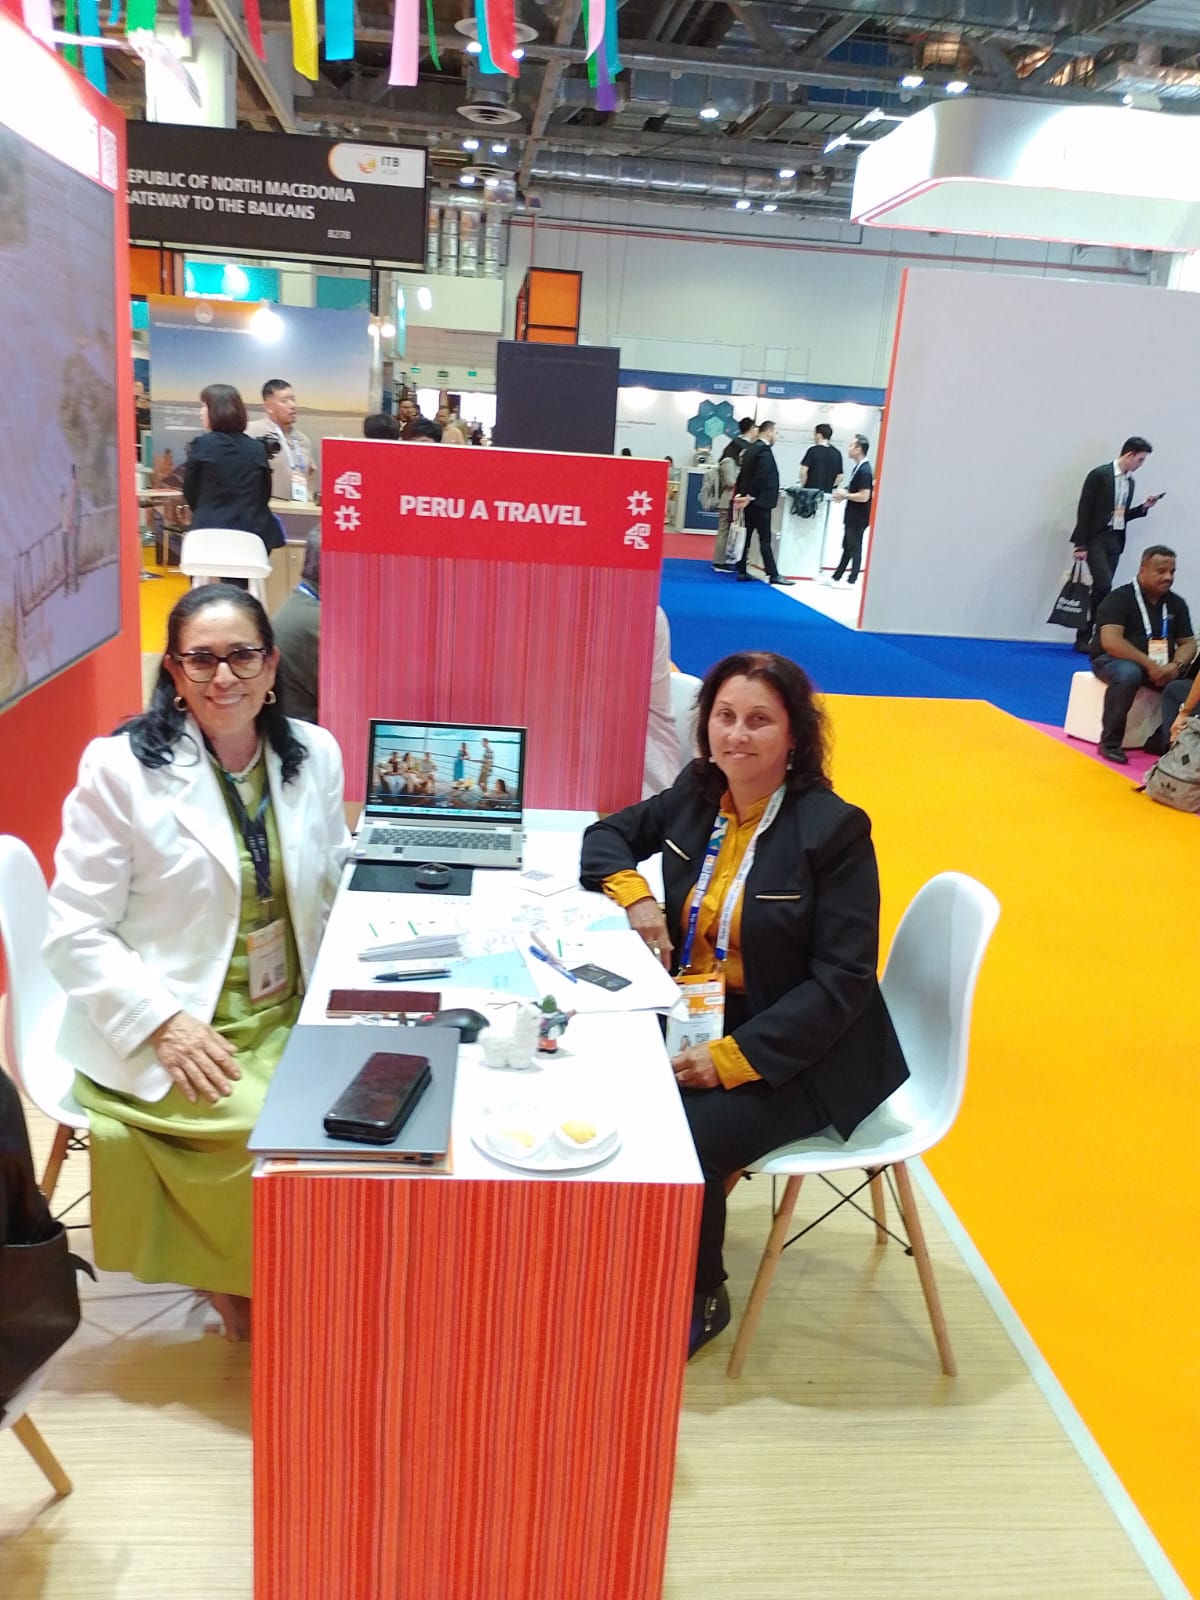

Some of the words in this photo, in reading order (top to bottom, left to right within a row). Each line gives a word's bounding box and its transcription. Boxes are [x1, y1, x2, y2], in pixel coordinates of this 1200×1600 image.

[380, 156, 400, 168] ITB
[127, 168, 186, 187] EPUBLIC
[187, 174, 209, 189] OF
[211, 175, 262, 194] NORTH
[265, 180, 356, 202] MACEDONIA
[192, 195, 215, 211] TO
[216, 197, 245, 213] THE
[247, 200, 316, 220] BALKANS
[400, 494, 466, 519] PERU
[469, 499, 489, 521] A
[493, 500, 588, 527] TRAVEL
